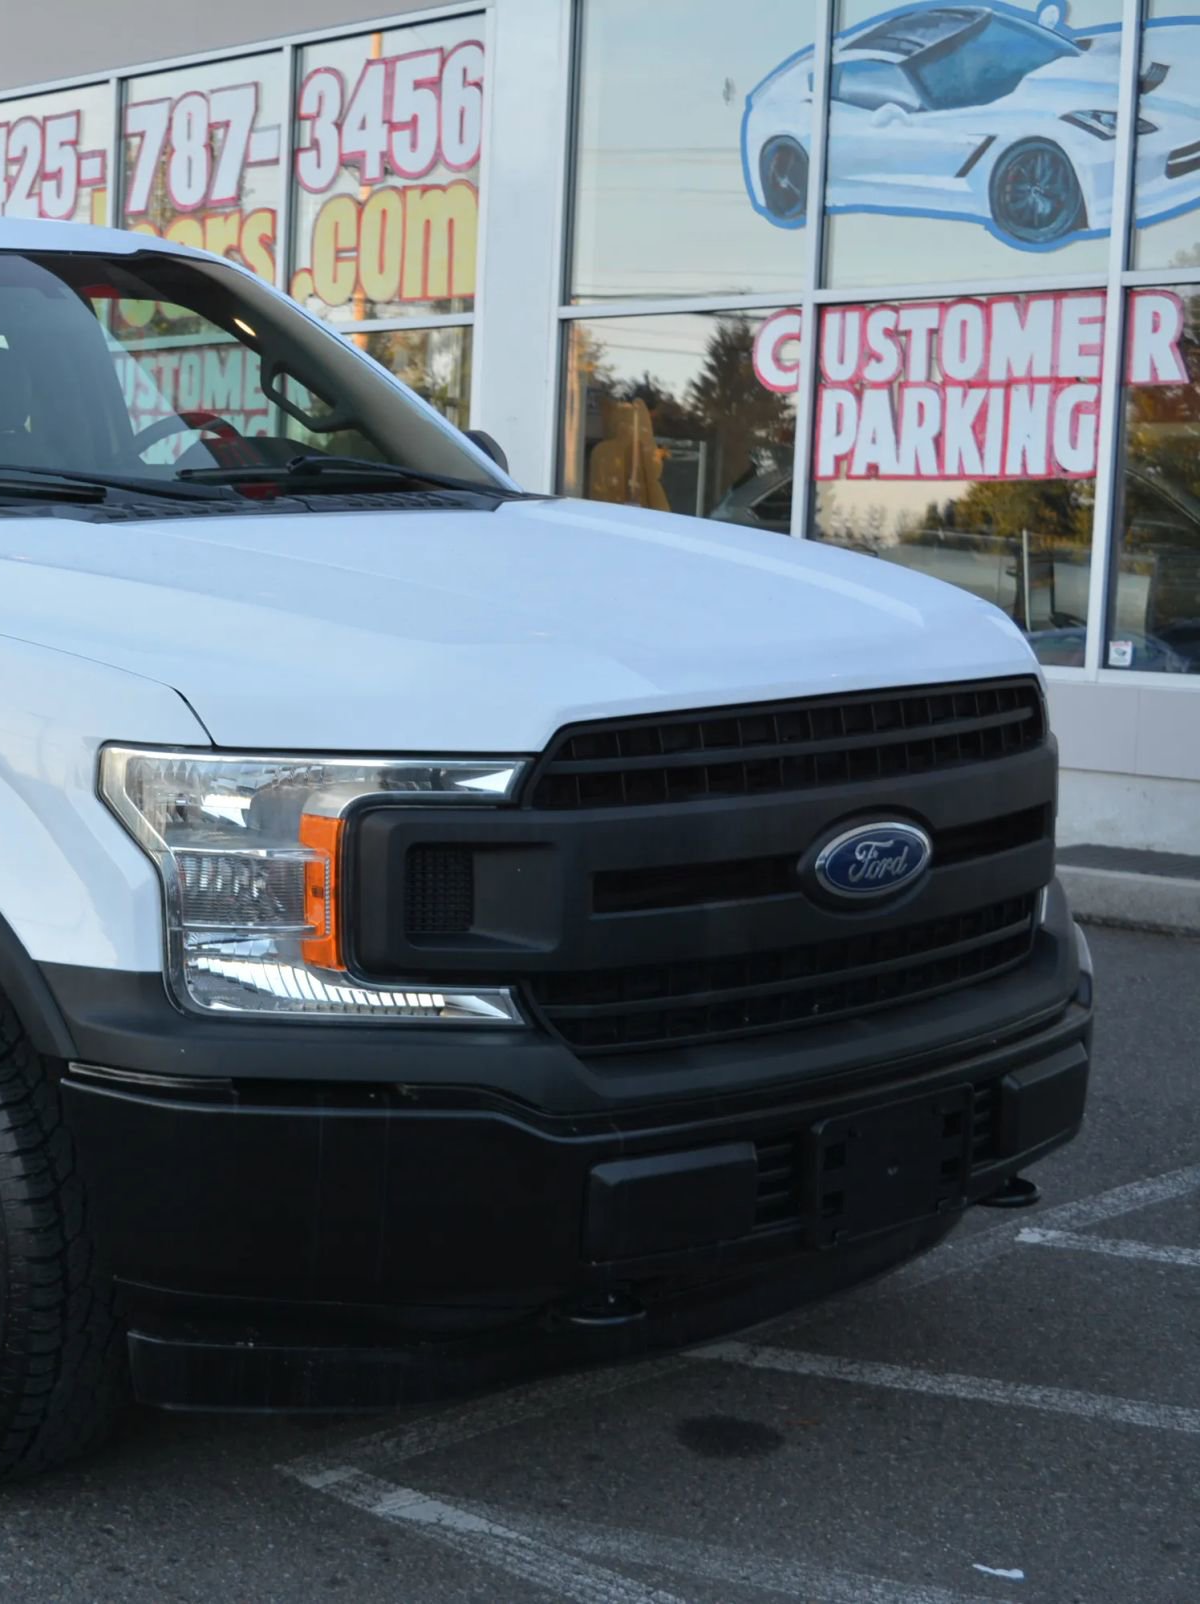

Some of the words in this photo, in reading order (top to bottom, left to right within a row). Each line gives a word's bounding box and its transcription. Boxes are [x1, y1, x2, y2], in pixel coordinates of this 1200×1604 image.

[753, 288, 1189, 392] CUSTOMER
[815, 382, 1098, 481] PARKING
[848, 839, 909, 882] Ford
